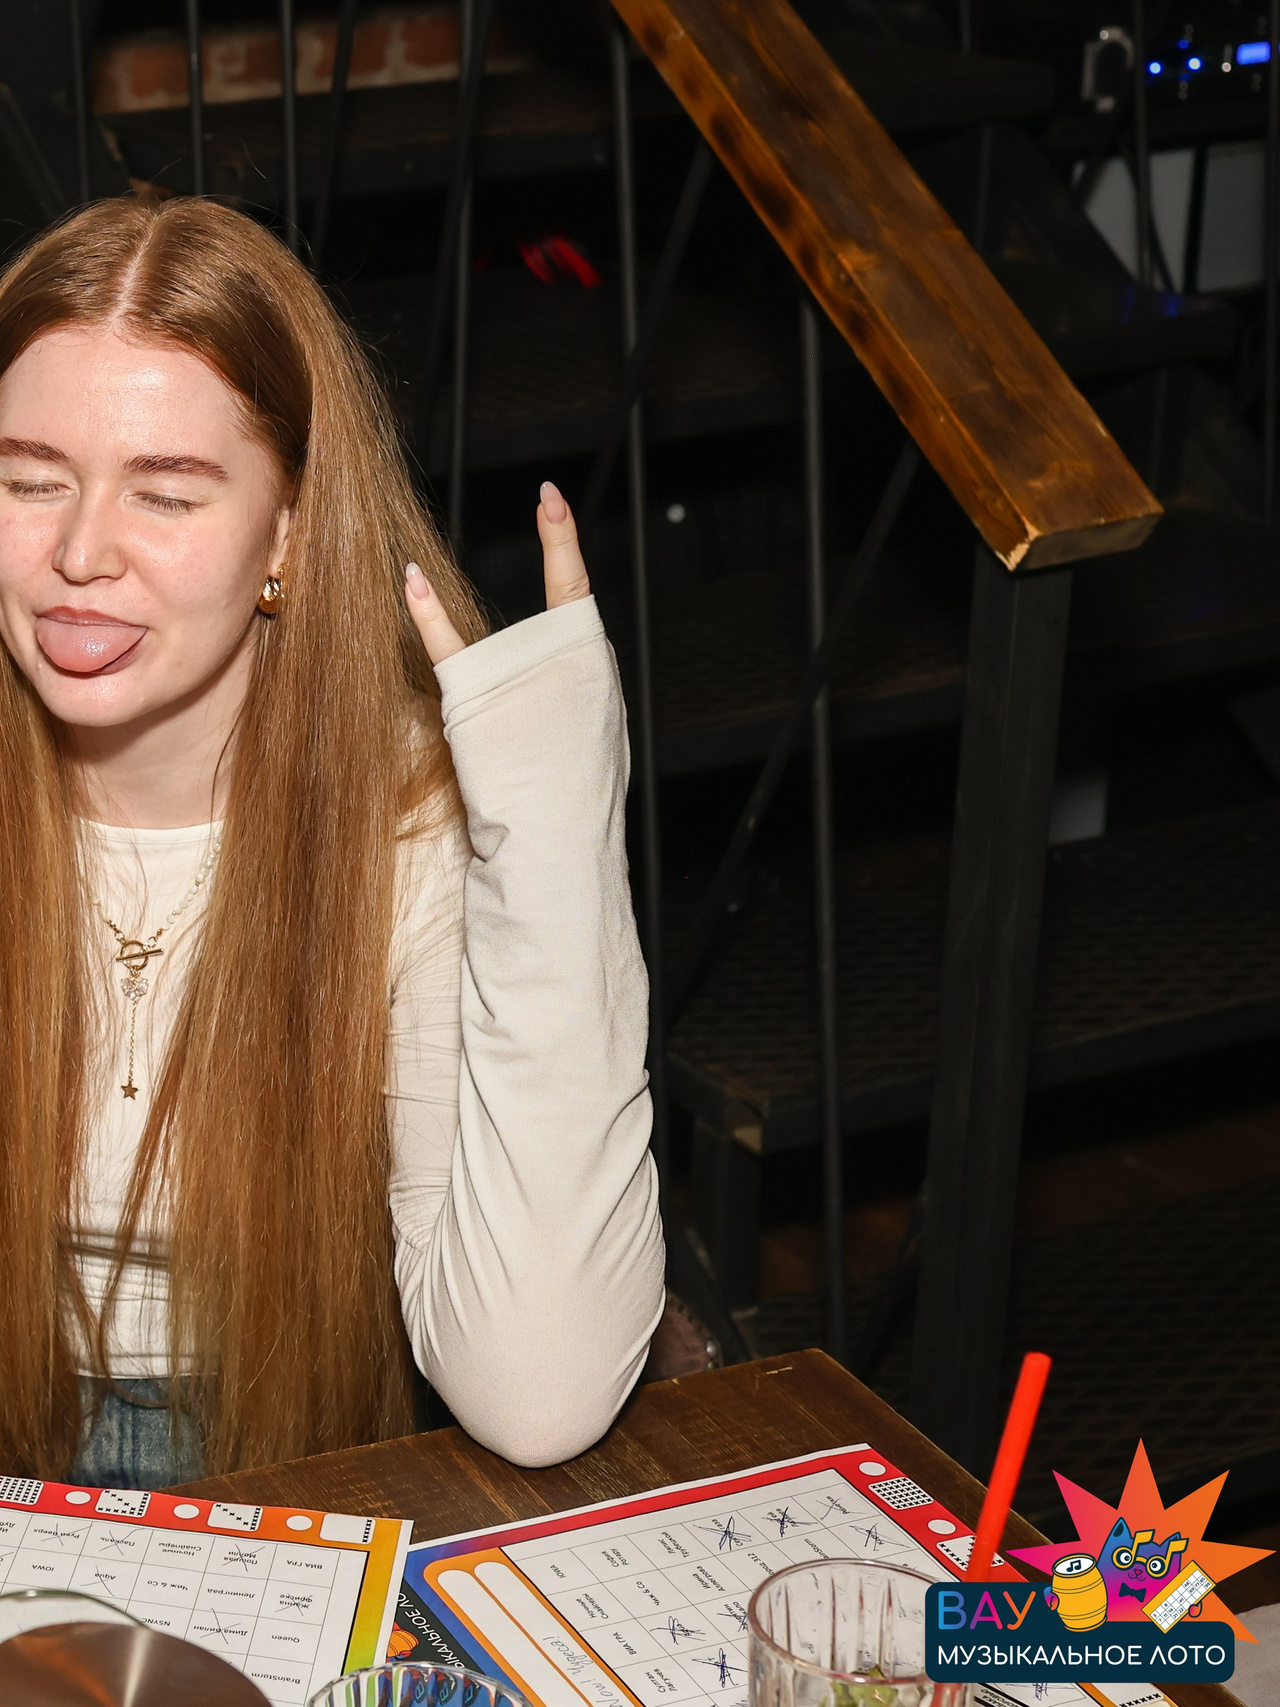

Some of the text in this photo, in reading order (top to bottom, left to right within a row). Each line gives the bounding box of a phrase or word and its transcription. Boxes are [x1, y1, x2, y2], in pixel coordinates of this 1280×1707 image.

[158, 1542, 202, 1552] Снайперы
[162, 1548, 195, 1556] Ночные
[657, 1538, 676, 1555] Ляпис
[661, 1531, 691, 1559] Трубецкой
[804, 1537, 830, 1559] ainStorm
[601, 1550, 620, 1568] София
[609, 1548, 630, 1566] Ротару
[747, 1552, 761, 1564] 312
[31, 1564, 55, 1572] IOWA
[94, 1572, 116, 1580] Aqua
[549, 1564, 566, 1579] IOWA
[692, 1572, 711, 1590] Ирина
[696, 1565, 726, 1592] Аллегрова
[169, 1583, 188, 1591] Чиж
[207, 1588, 256, 1598] Ленинград
[575, 1598, 597, 1618] Ночные
[582, 1593, 609, 1620] Снайперы
[648, 1594, 661, 1607] Чиж
[223, 1628, 248, 1636] Дима
[271, 1634, 300, 1644] Queen
[612, 1631, 637, 1656] ВИА ГРА
[251, 1672, 301, 1685] BrainStorm
[644, 1671, 666, 1694] Султан
[653, 1668, 678, 1692] Лагучев
